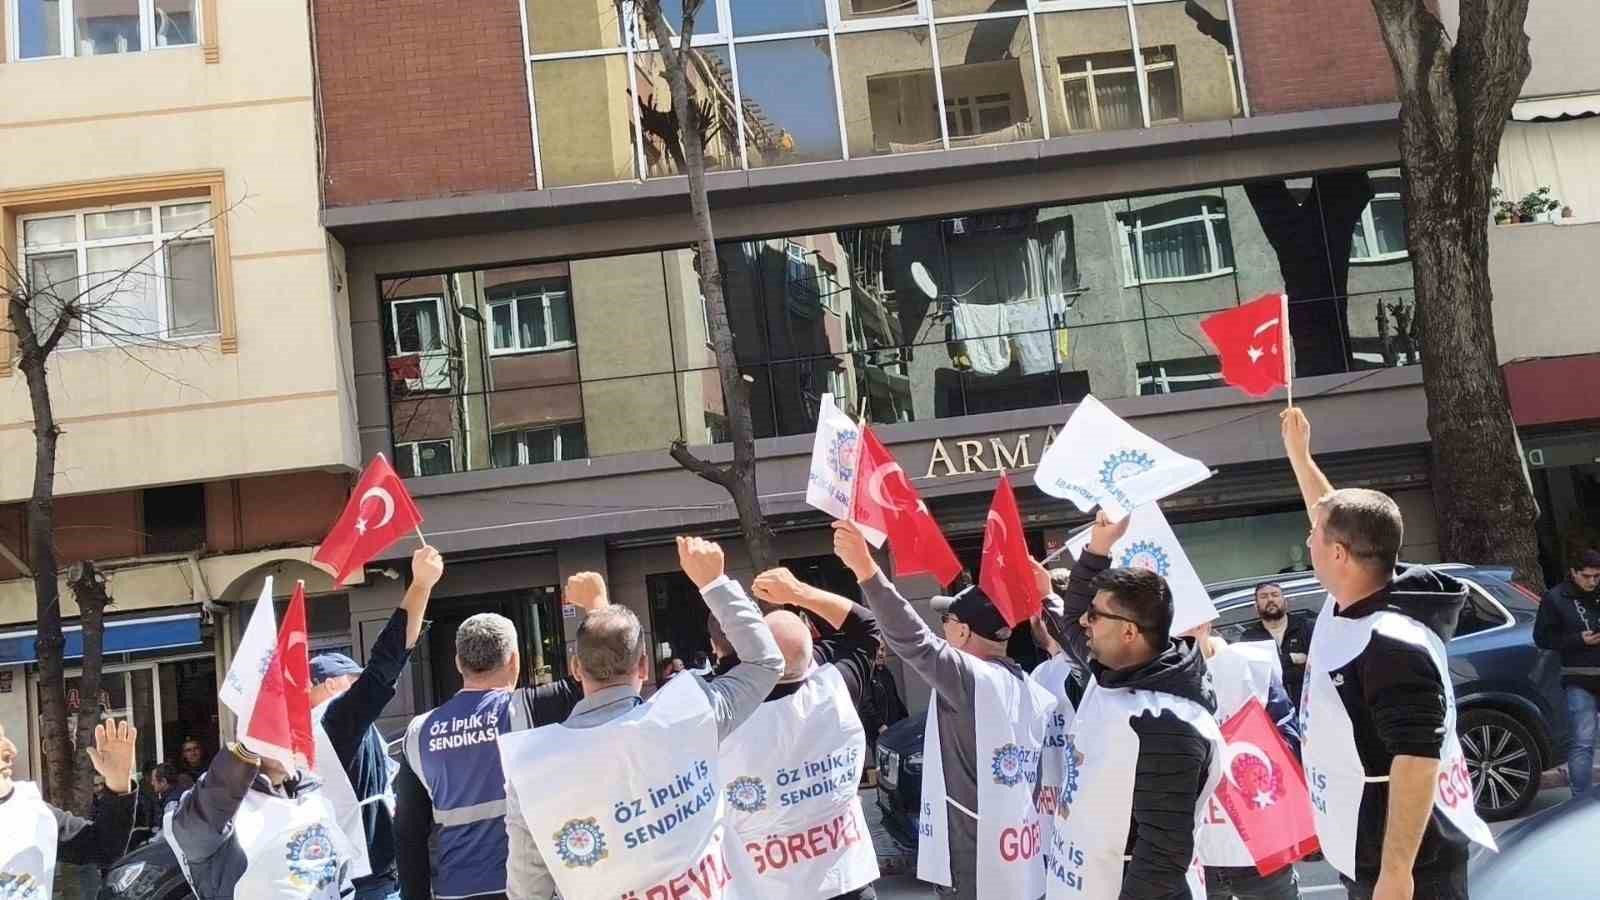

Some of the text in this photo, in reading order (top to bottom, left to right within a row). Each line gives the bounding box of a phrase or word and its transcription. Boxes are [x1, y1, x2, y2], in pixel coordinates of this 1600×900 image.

[430, 720, 448, 736] ÖZ
[452, 717, 483, 732] İPLİK
[776, 768, 800, 786] ÖZ
[804, 753, 843, 779] İPLİK
[780, 766, 857, 806] SENDİKASI
[614, 798, 647, 823] ÖZ
[648, 772, 695, 809] İPLİK
[624, 783, 716, 849] SENDİKASI
[1069, 841, 1084, 869] İŞ
